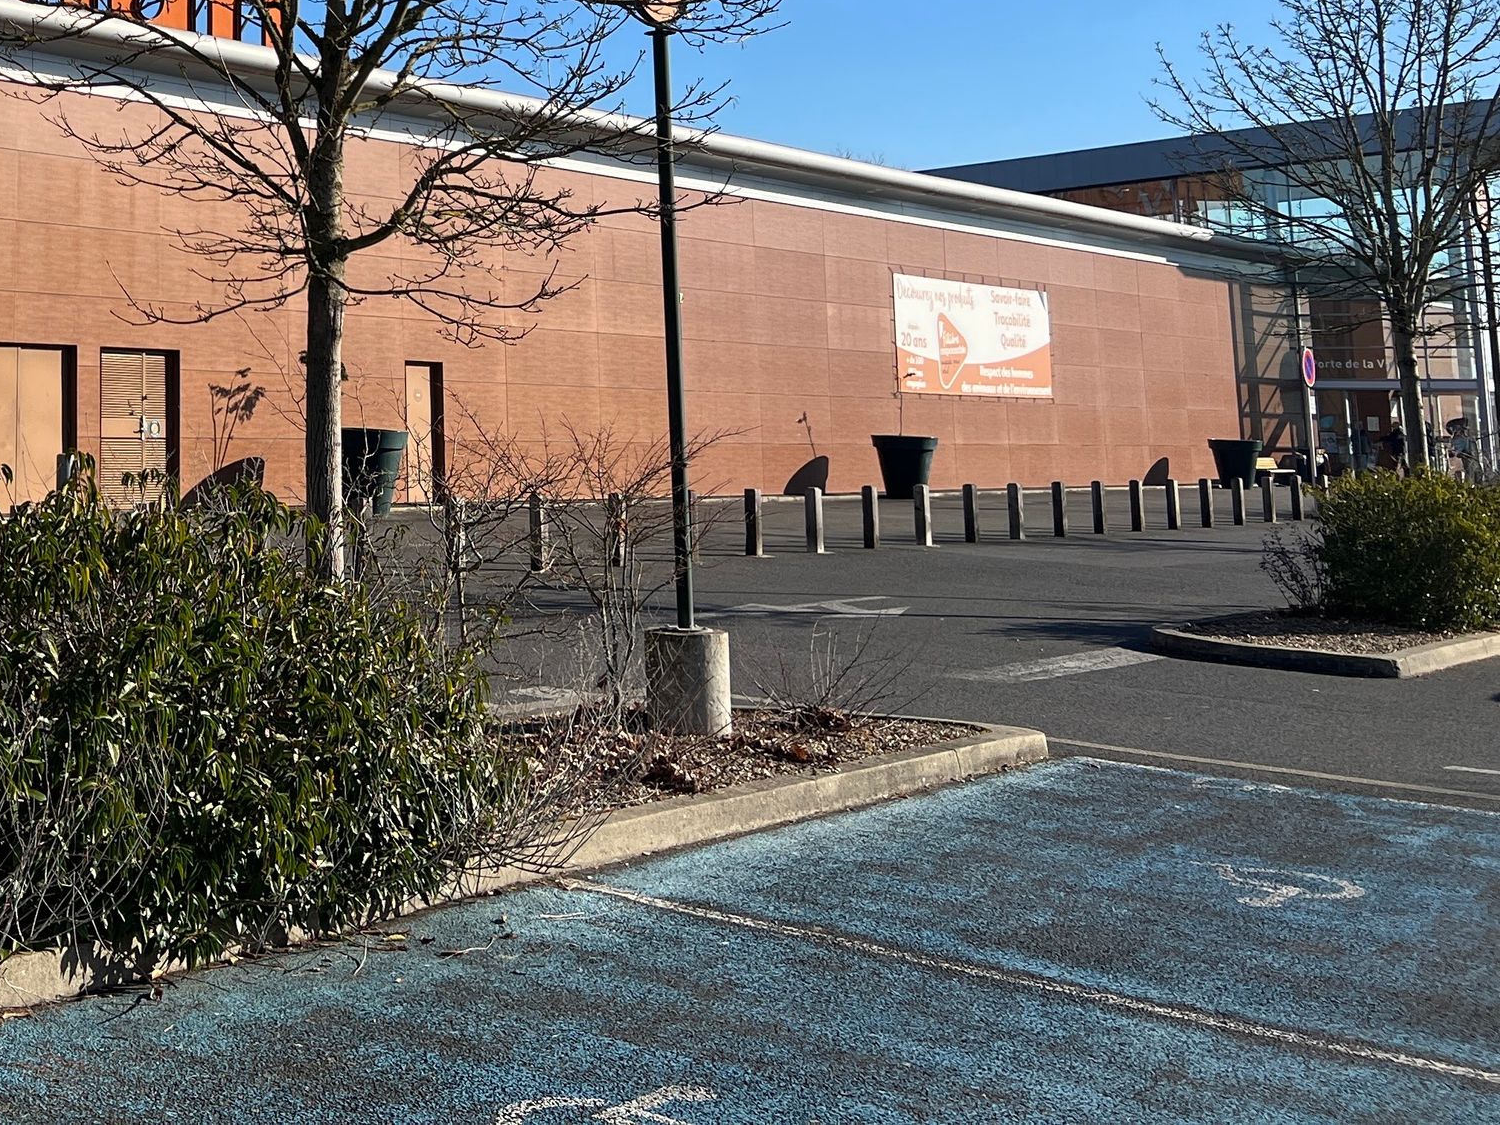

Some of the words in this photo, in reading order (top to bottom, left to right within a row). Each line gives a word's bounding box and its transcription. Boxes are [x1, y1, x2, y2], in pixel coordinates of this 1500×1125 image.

[901, 332, 912, 347] 20
[913, 336, 928, 349] ans
[1313, 359, 1342, 369] orte
[1362, 359, 1374, 369] la
